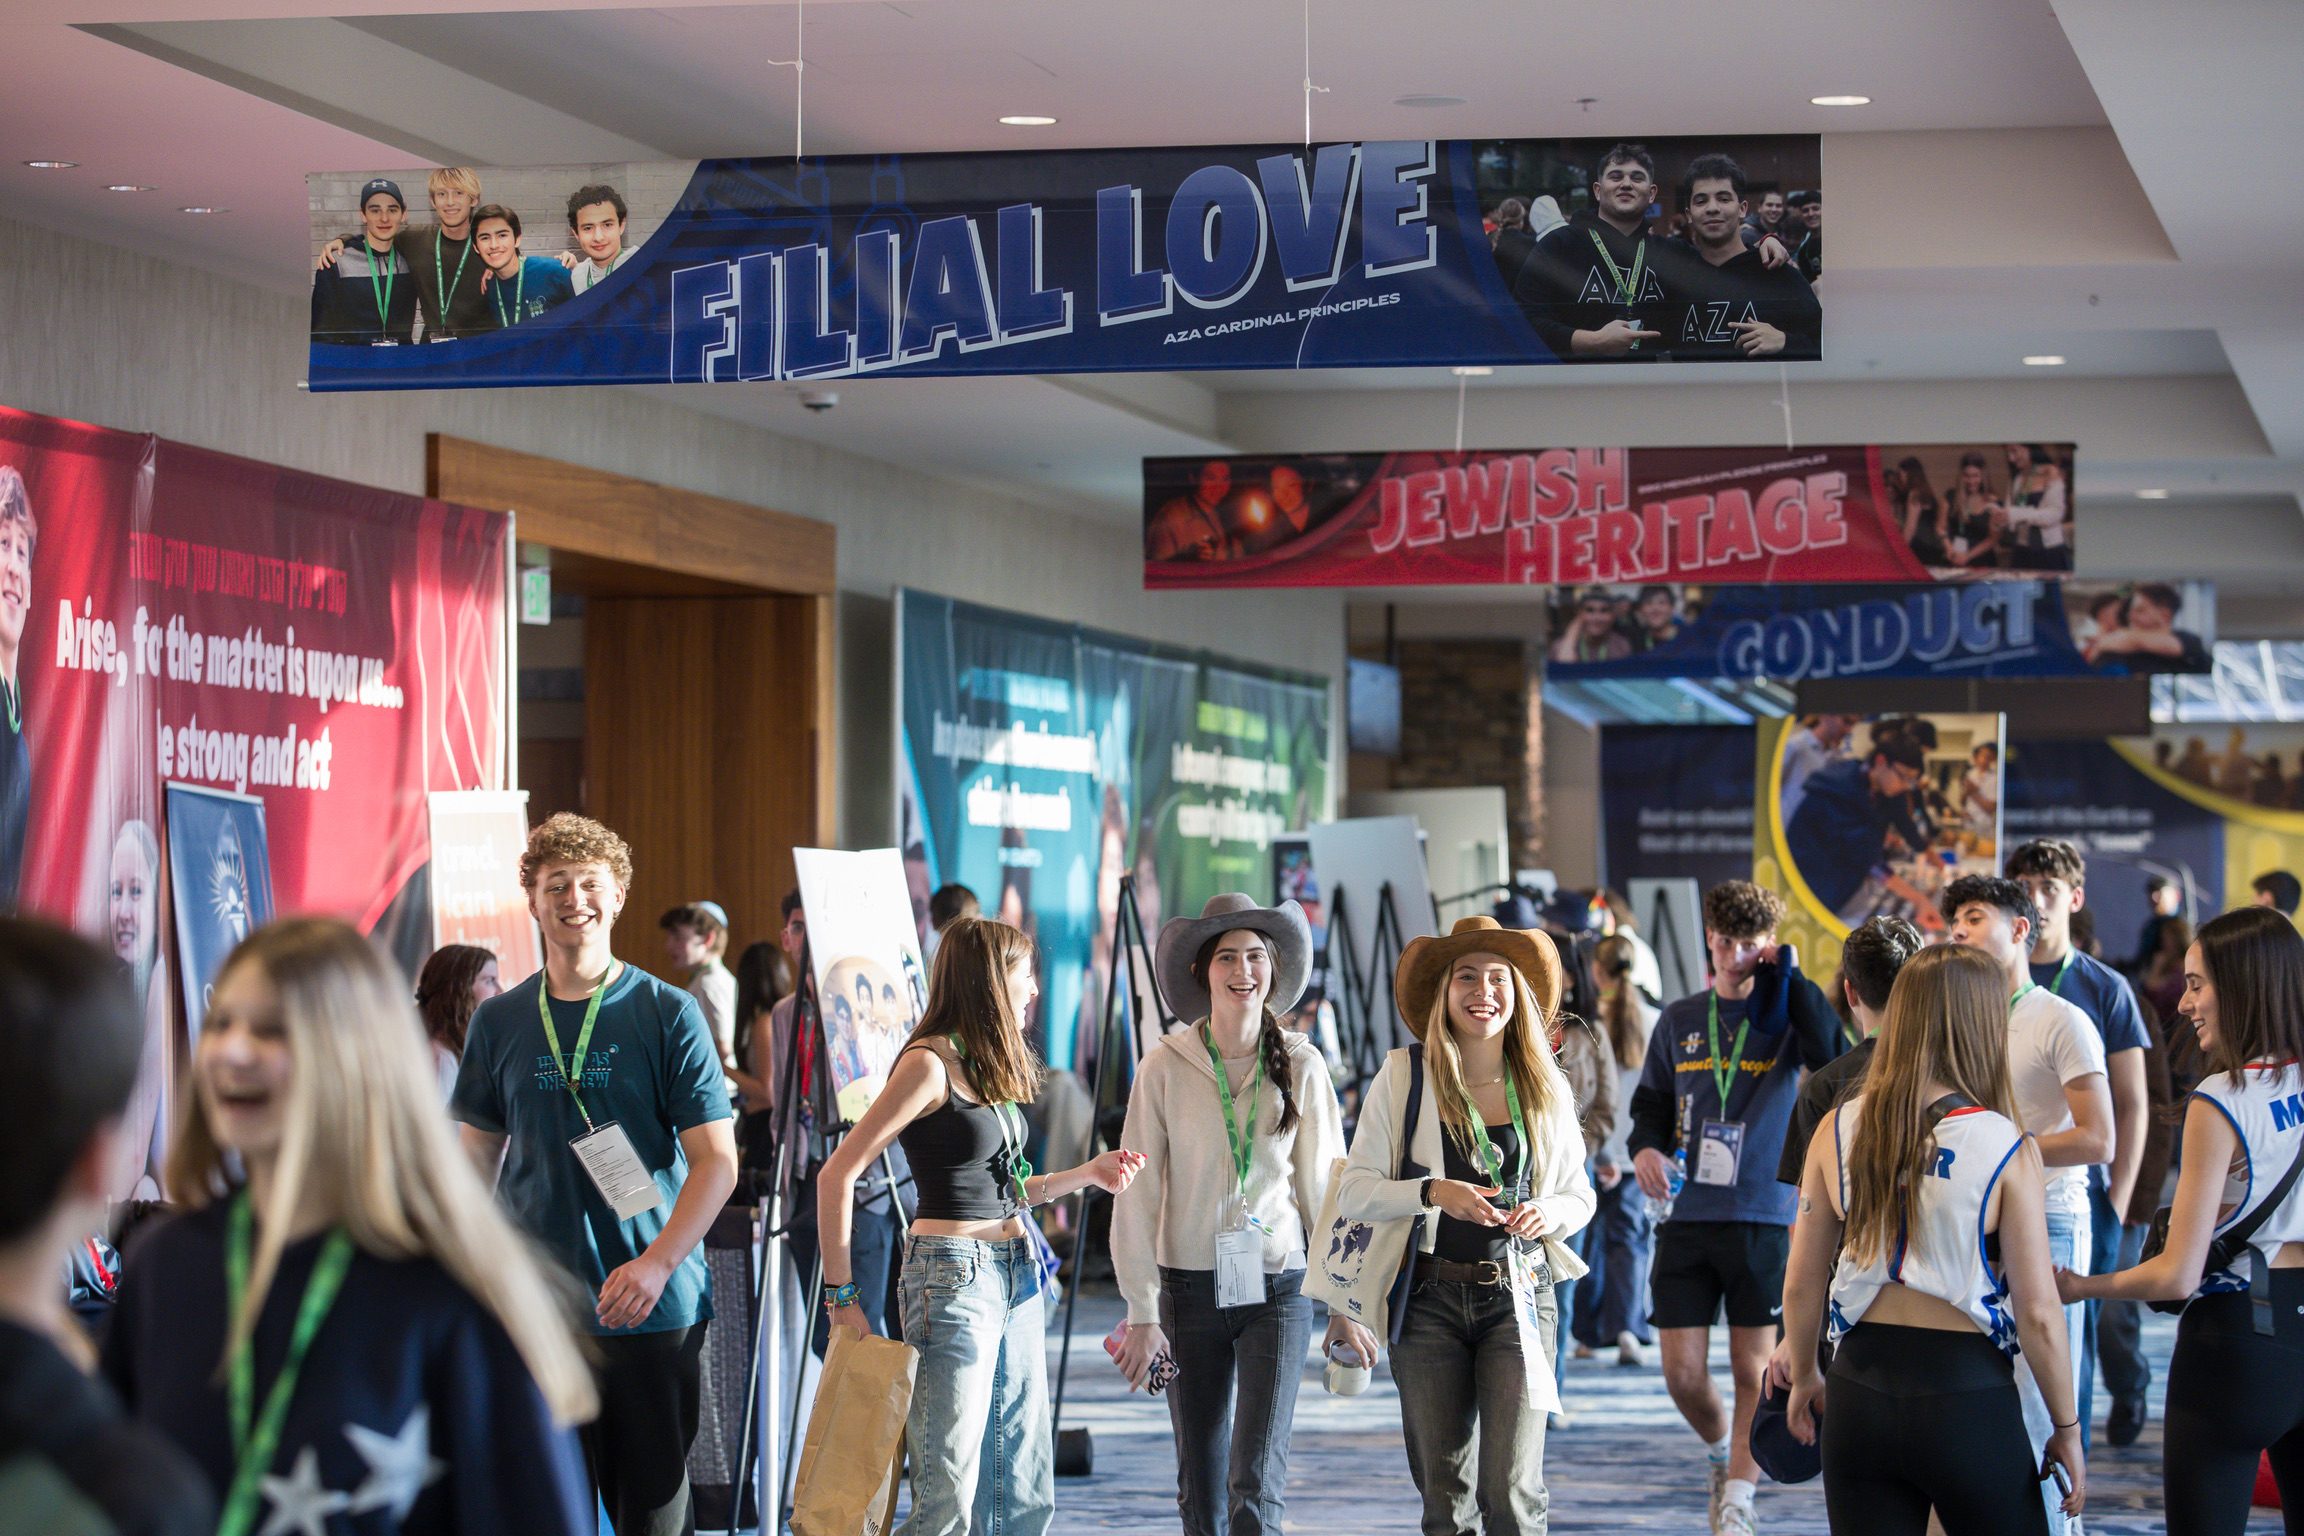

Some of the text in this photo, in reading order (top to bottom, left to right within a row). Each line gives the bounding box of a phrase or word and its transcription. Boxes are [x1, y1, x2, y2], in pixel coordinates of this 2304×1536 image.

[671, 141, 1437, 383] FILIAL LOVE
[1163, 292, 1401, 345] AZA CARDINAL PRINCIPLES
[1369, 447, 1629, 553] JEWISH
[1505, 470, 1848, 584] HERITAGE
[56, 595, 404, 713] Arise, fo the matter is upon us...
[1718, 580, 2045, 684] CONDUCT
[177, 713, 249, 794] strong
[251, 723, 296, 787] and
[296, 726, 332, 791] act
[576, 1070, 610, 1089] REW
[2269, 1090, 2304, 1132] M
